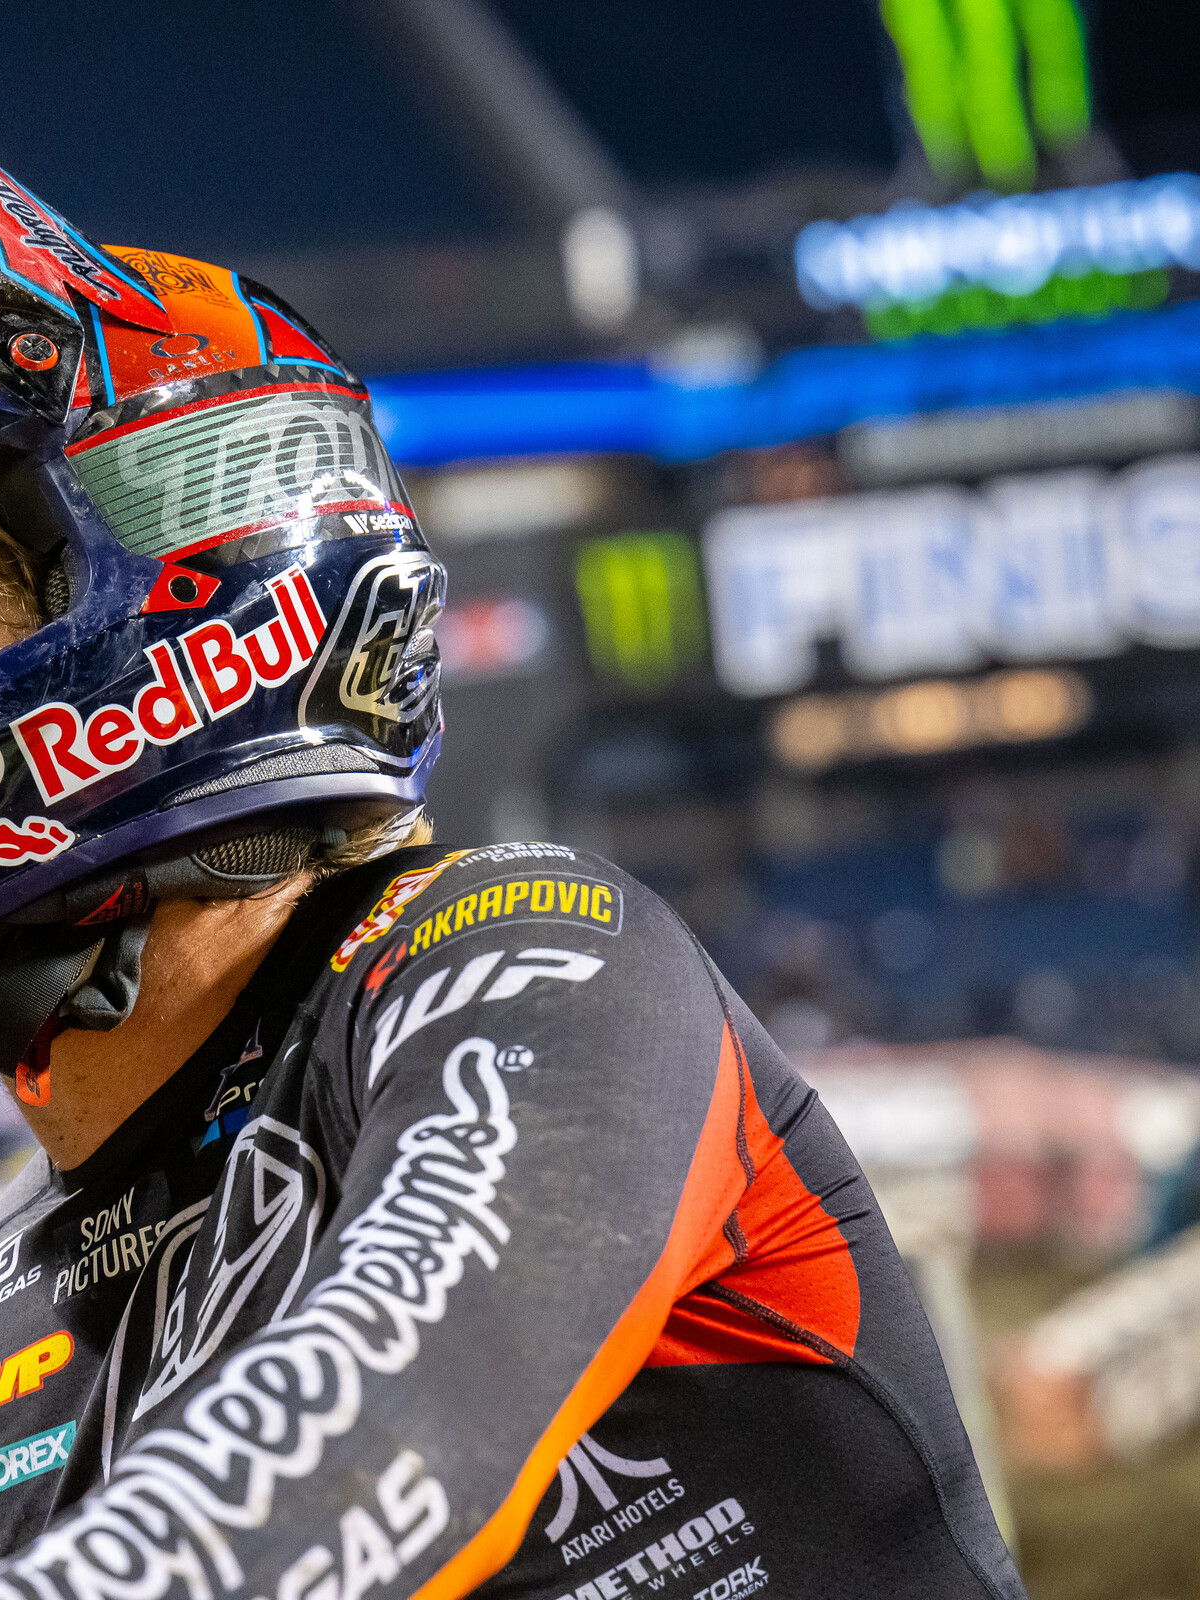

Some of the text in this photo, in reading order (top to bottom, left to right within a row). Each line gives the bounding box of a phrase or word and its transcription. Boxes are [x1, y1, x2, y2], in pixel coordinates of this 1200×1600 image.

[12, 642, 202, 803] Red
[180, 564, 329, 719] Bull
[216, 1078, 265, 1116] Pr
[81, 1187, 134, 1252] SONY
[561, 1478, 685, 1566] ATARI HOTELS
[647, 1521, 755, 1592] WHEELS
